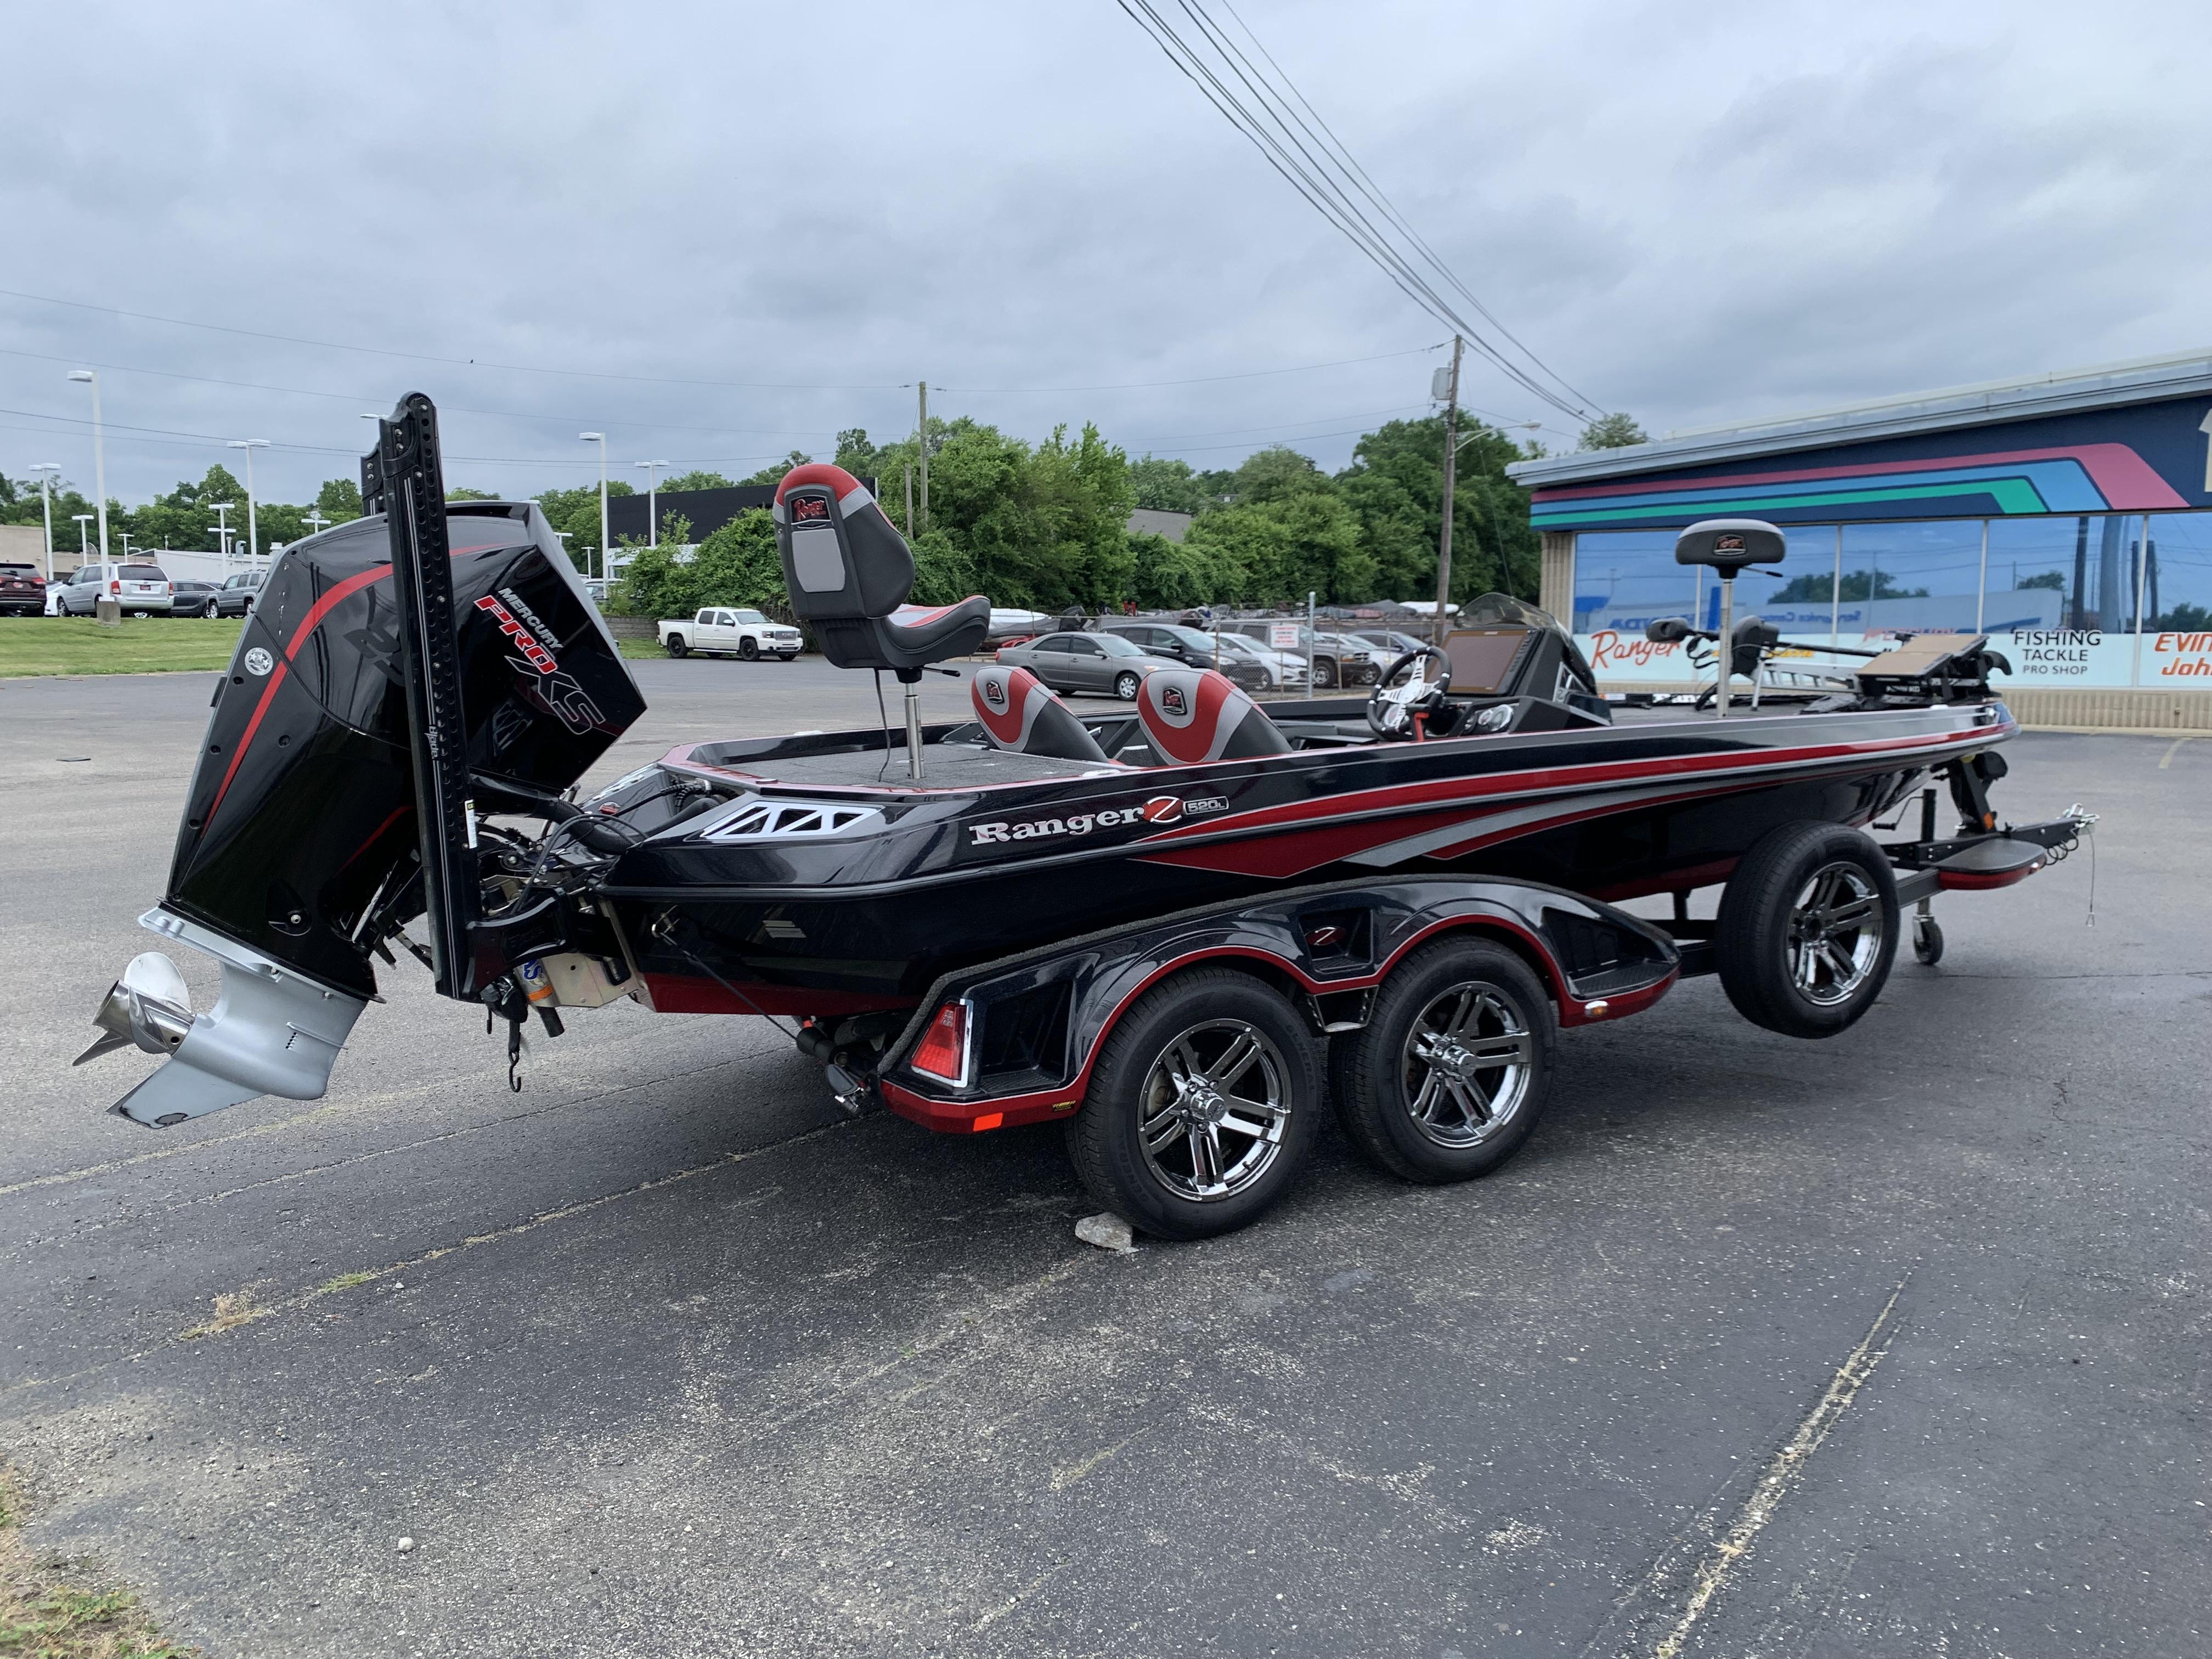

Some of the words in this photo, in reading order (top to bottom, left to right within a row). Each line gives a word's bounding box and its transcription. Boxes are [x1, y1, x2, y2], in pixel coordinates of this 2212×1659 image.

[498, 588, 563, 649] MERCURY
[473, 595, 558, 674] PRO
[2015, 630, 2102, 646] FISHING
[1590, 630, 1681, 667] Ranger
[2022, 649, 2089, 661] TACKLE
[2023, 665, 2047, 674] PRO
[2052, 665, 2087, 675] SHOP
[2162, 657, 2212, 675] Joh
[969, 806, 1145, 845] Ranger
